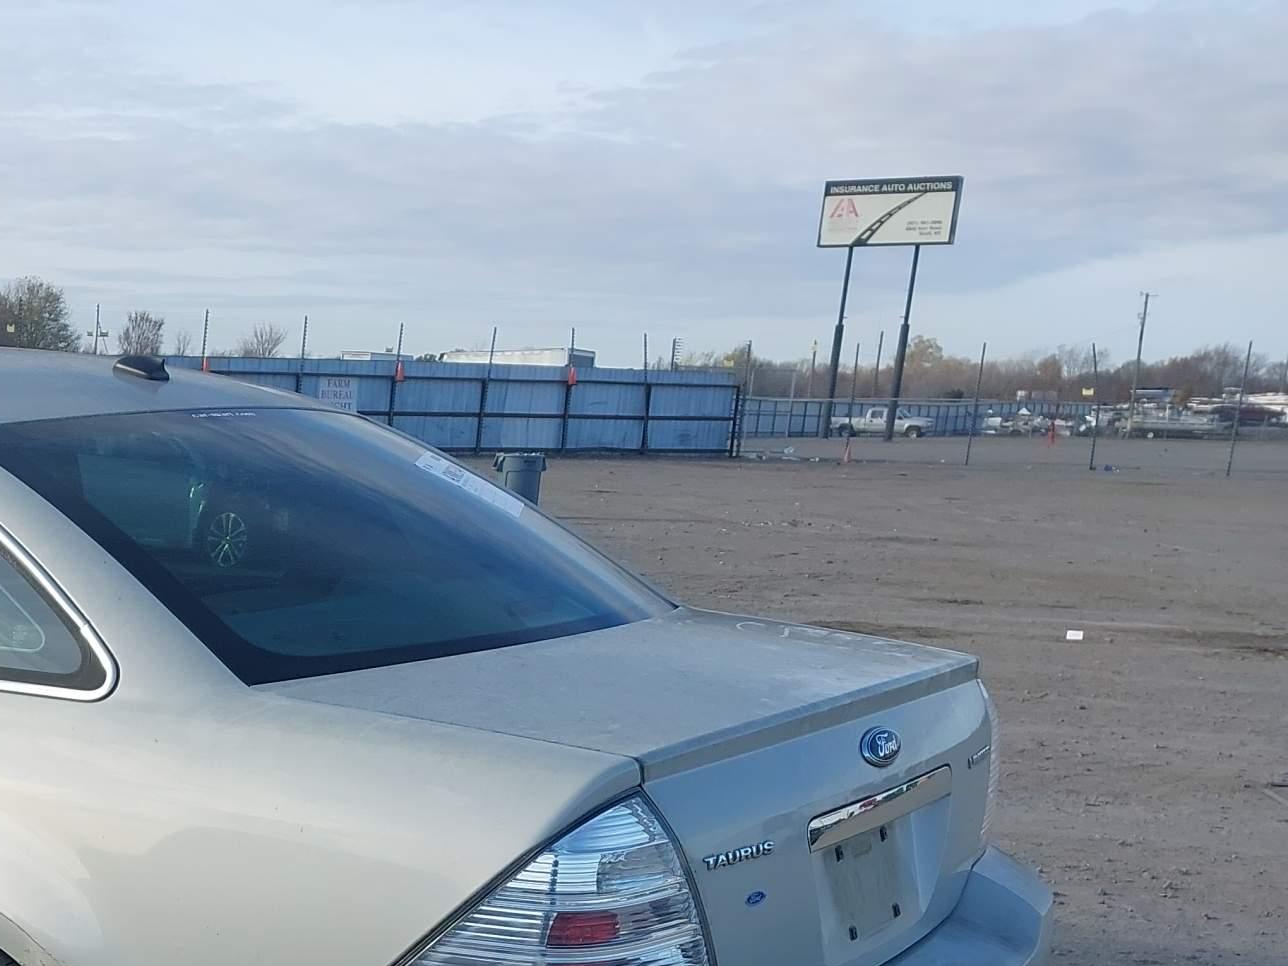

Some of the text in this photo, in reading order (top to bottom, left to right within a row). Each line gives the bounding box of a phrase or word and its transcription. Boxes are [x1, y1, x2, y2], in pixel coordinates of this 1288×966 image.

[830, 181, 953, 194] INSURANCE AUTO AUCTIONS
[327, 379, 351, 389] FARM
[875, 732, 898, 757] Ford
[702, 840, 775, 871] TAURUS
